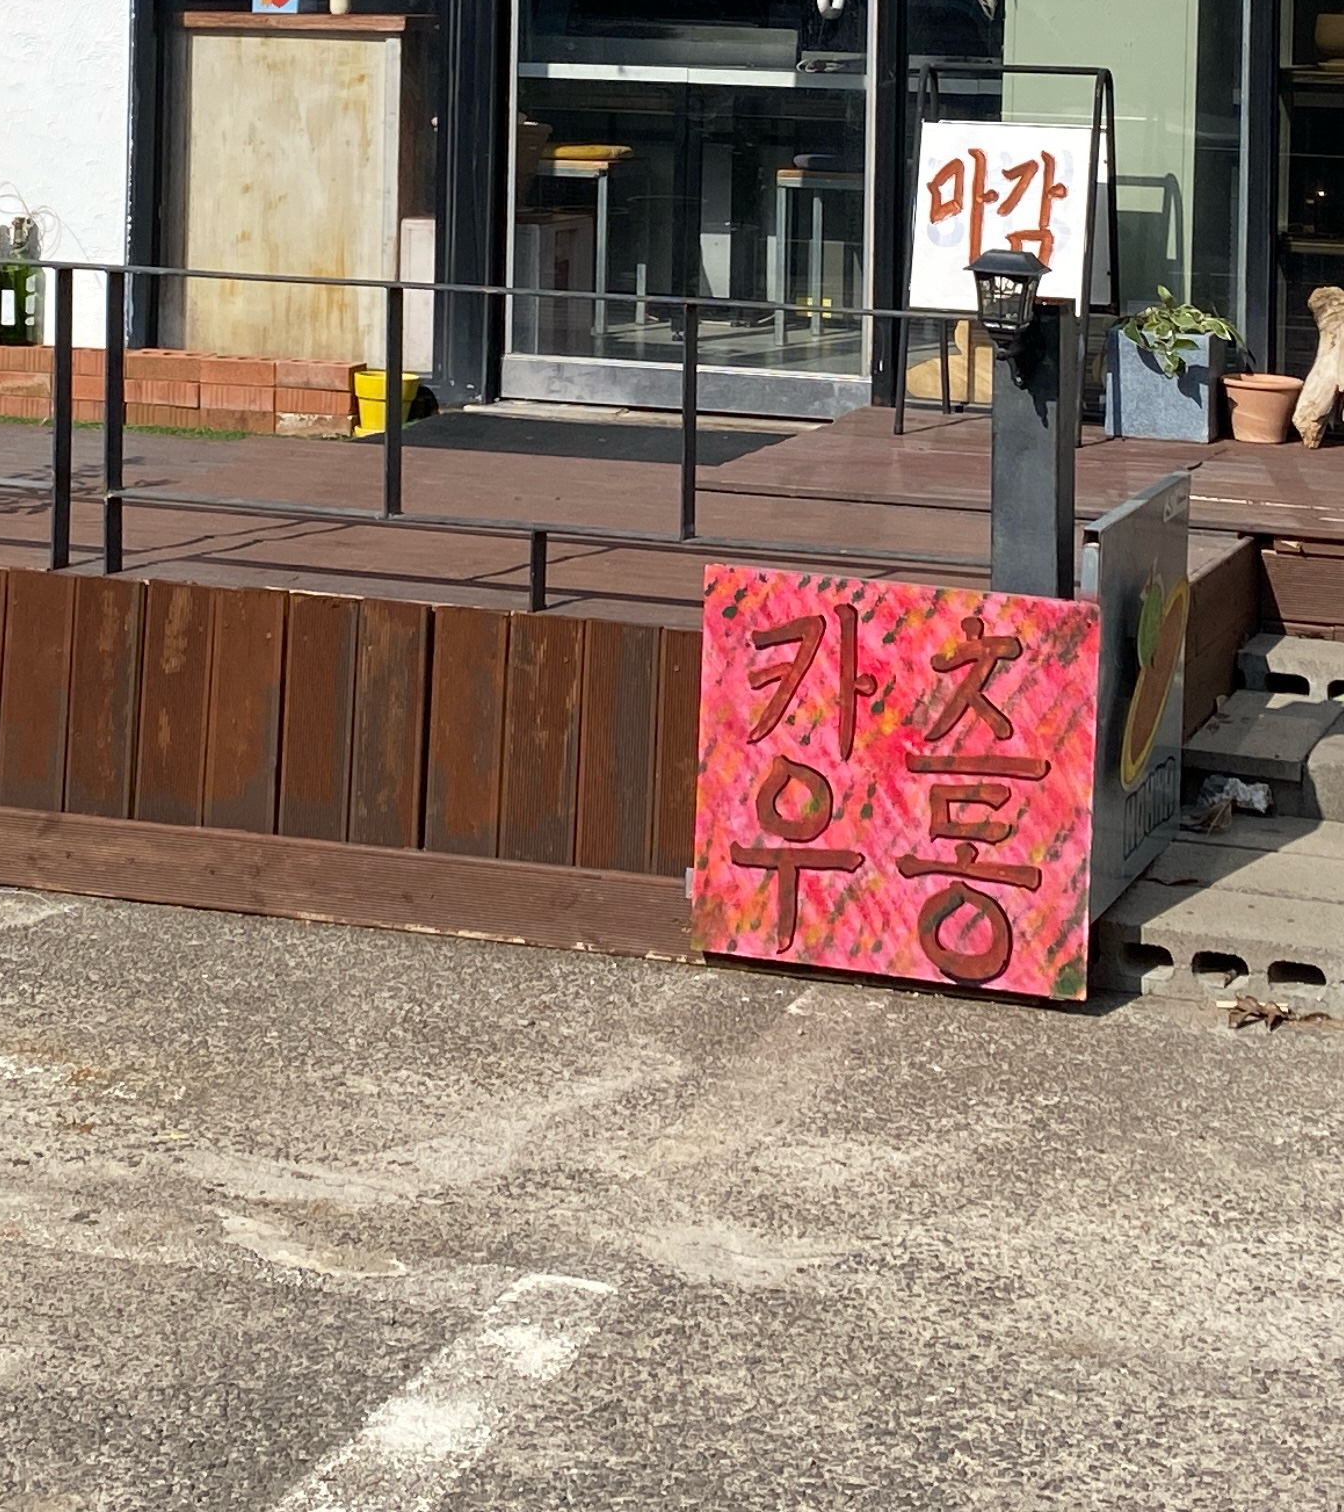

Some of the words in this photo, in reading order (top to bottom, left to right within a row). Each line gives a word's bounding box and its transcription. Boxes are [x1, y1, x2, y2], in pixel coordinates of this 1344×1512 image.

[926, 148, 1069, 269] 마감
[746, 602, 1053, 782] 카츠
[729, 754, 1044, 986] 우동
